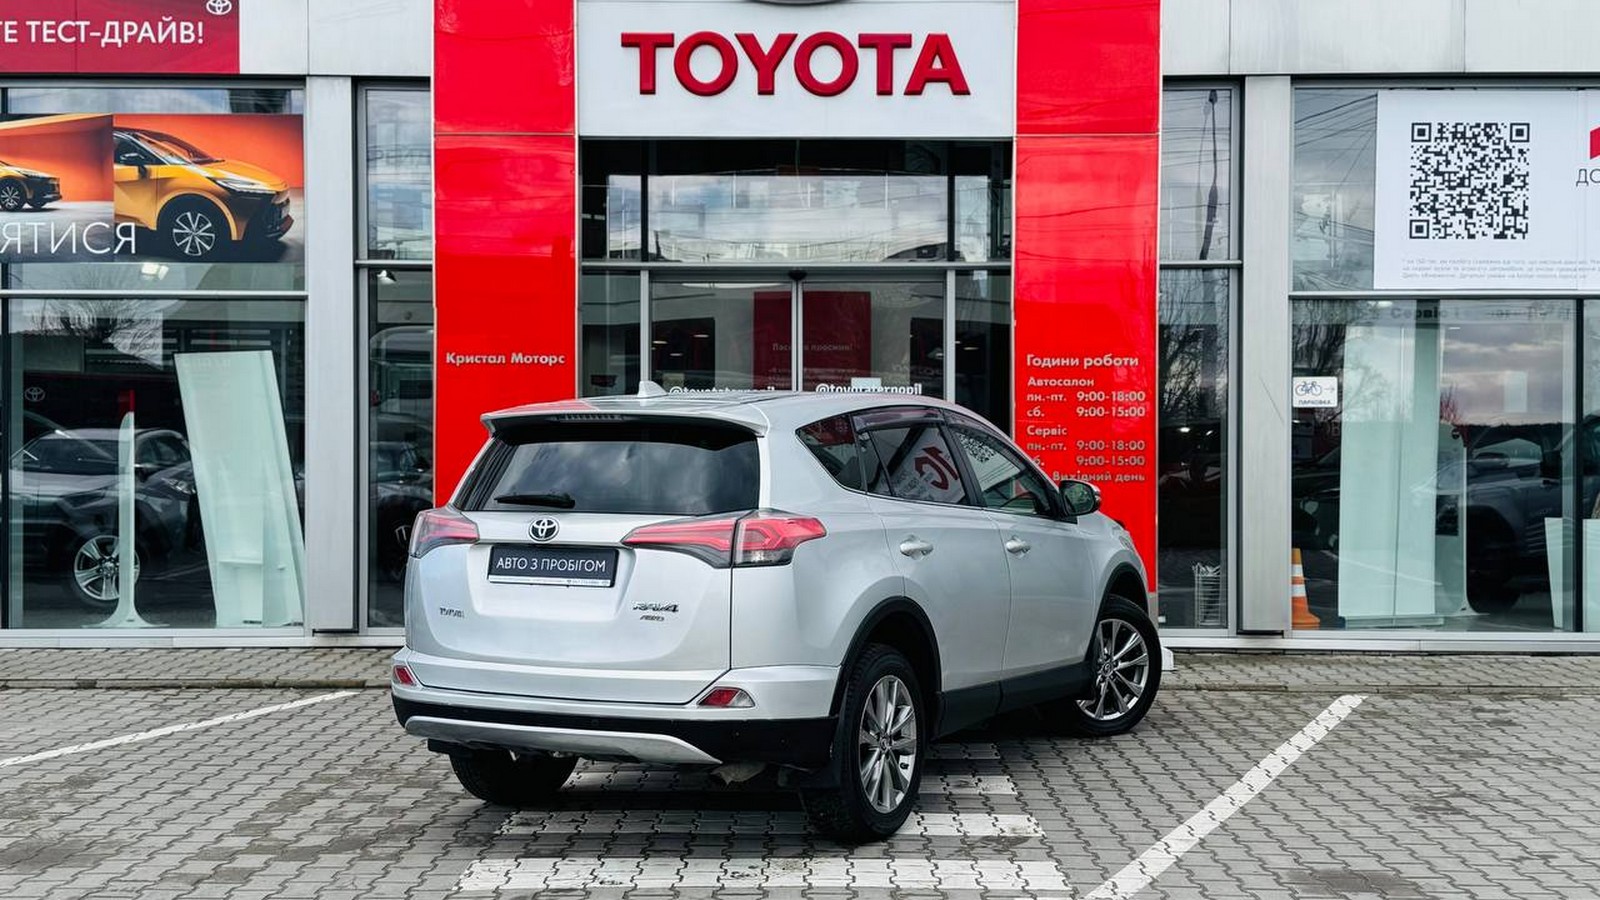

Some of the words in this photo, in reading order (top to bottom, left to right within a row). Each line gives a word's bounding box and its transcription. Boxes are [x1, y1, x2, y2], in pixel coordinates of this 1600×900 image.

[0, 20, 18, 43] Е
[25, 15, 204, 48] ТЕСТ-ДРАЙВ!
[621, 31, 971, 97] TOYOTA
[0, 221, 137, 255] ЯТИСЯ
[446, 352, 506, 366] Кристал
[511, 352, 565, 366] Моторс
[1026, 354, 1080, 367] Години
[1083, 353, 1139, 369] роботи
[1027, 376, 1095, 387] Автосалон
[1026, 393, 1067, 401] пн.-пт.
[1076, 391, 1146, 401] 9:00-18:00
[1026, 405, 1045, 417] сб.
[1076, 406, 1146, 417] 9:00-15:00
[1026, 424, 1068, 437] Сервіс
[1026, 443, 1067, 451] пн.-пт.
[1076, 440, 1146, 451] 9:00-18:00
[1076, 455, 1146, 466] 9:00-15:00
[1052, 470, 1112, 481] Вихідний
[1115, 473, 1146, 482] день
[496, 557, 528, 570] АВТО
[540, 558, 607, 573] ПРОБІГОМ
